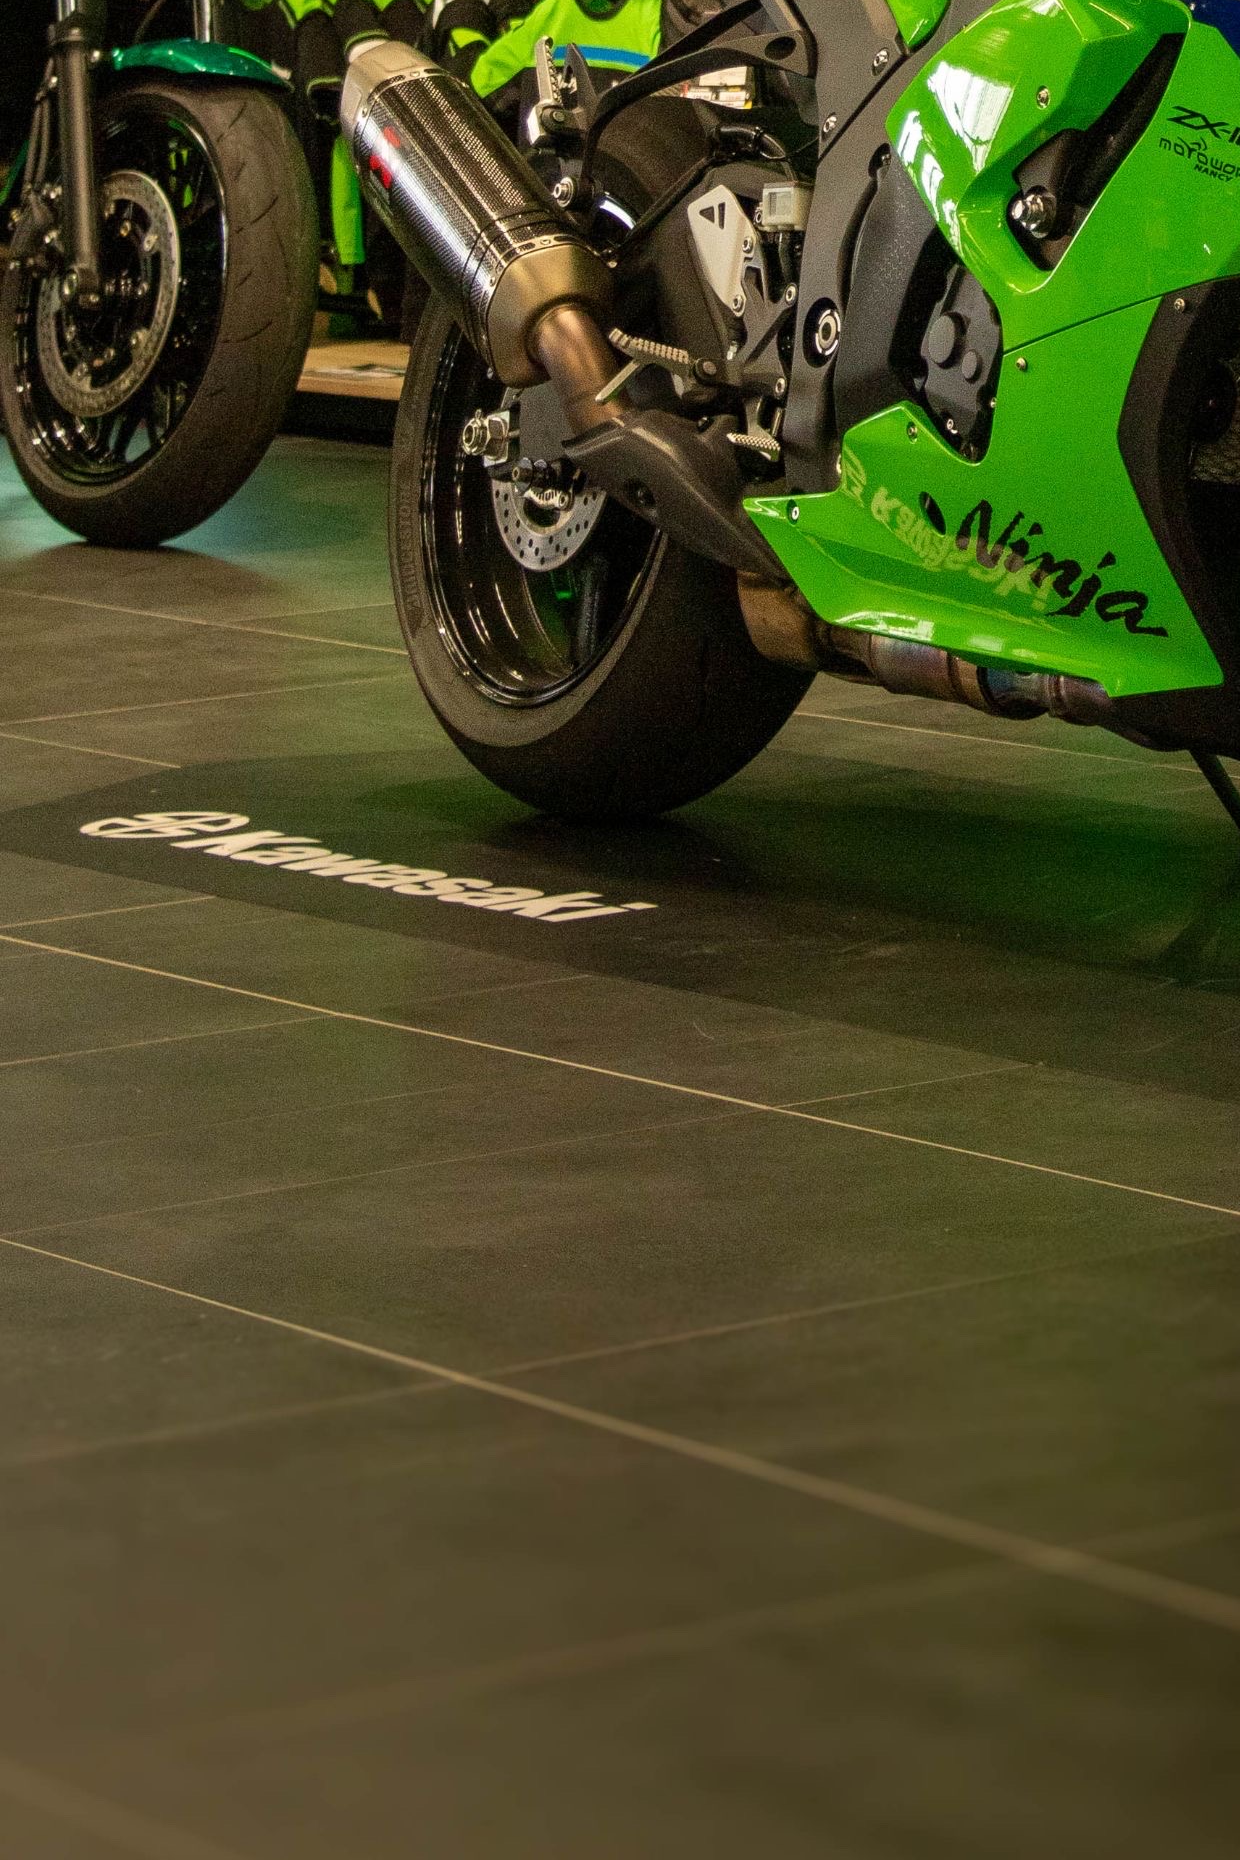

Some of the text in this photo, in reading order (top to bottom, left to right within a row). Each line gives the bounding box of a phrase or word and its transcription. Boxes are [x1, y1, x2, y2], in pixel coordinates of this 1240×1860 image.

[1193, 163, 1233, 183] NANCY
[955, 499, 1169, 638] Ninja
[170, 830, 659, 923] Kawasaki
